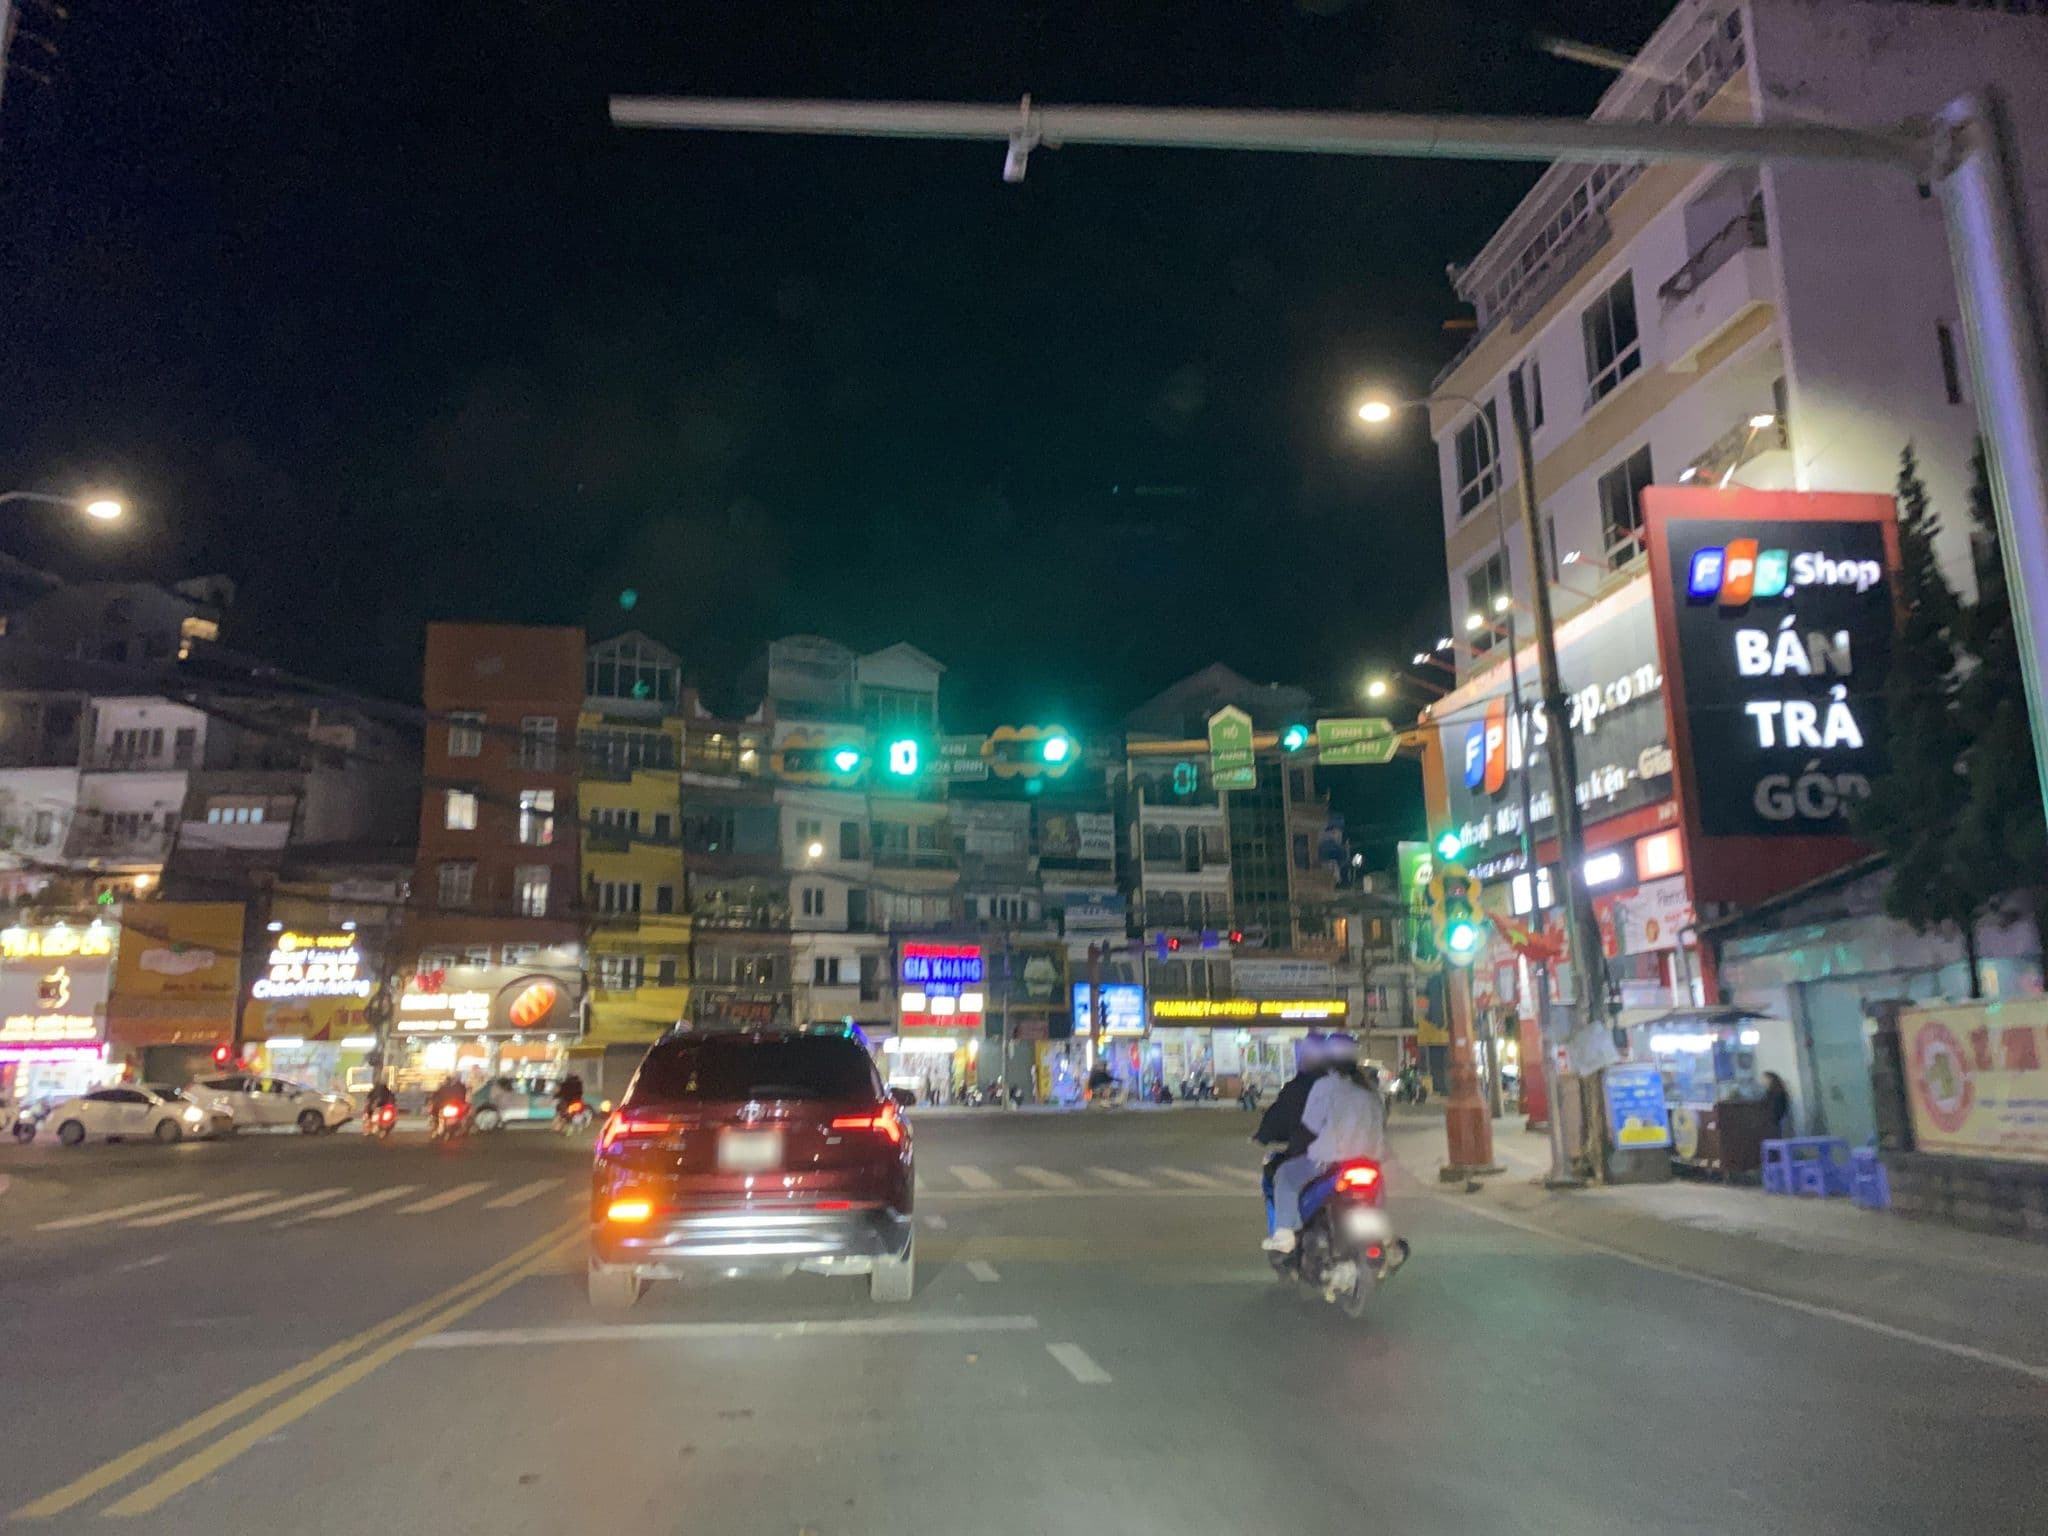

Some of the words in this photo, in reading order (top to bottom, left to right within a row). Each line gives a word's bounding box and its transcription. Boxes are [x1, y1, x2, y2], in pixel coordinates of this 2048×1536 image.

[1792, 551, 1881, 592] Shop
[1735, 614, 1853, 677] BÁN
[1745, 684, 1864, 749] TRẢ
[889, 739, 918, 775] 10
